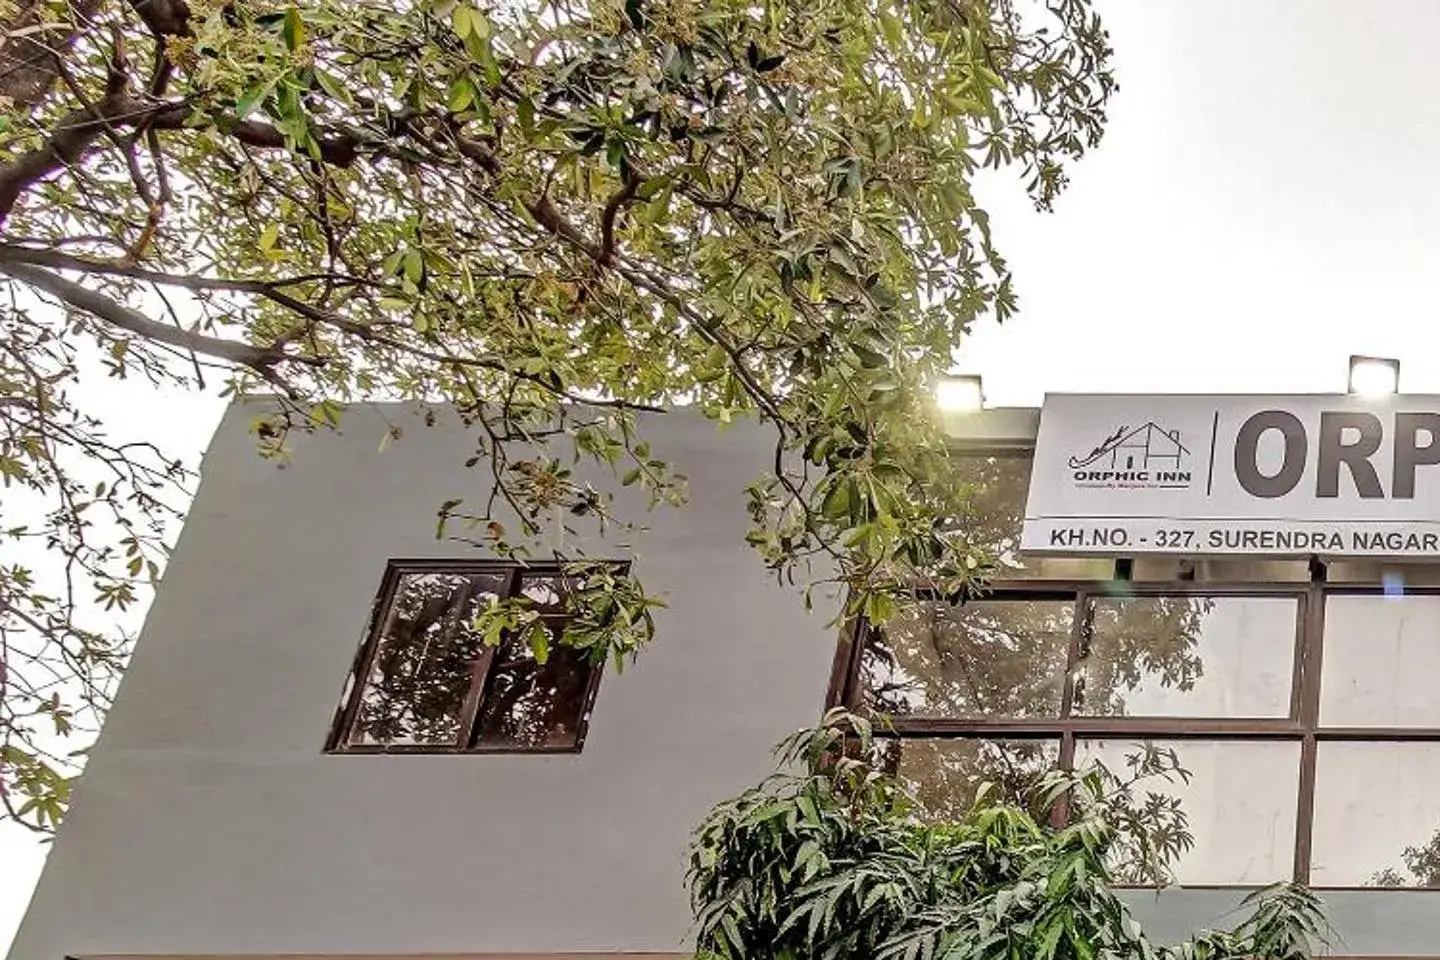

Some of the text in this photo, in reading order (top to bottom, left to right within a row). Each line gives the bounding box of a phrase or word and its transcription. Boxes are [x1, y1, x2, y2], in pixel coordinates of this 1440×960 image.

[1074, 472, 1191, 481] ORPHIC INN
[1050, 529, 1134, 547] KH.NO.
[1155, 530, 1201, 551] 327,
[1208, 530, 1344, 551] SURENDRA
